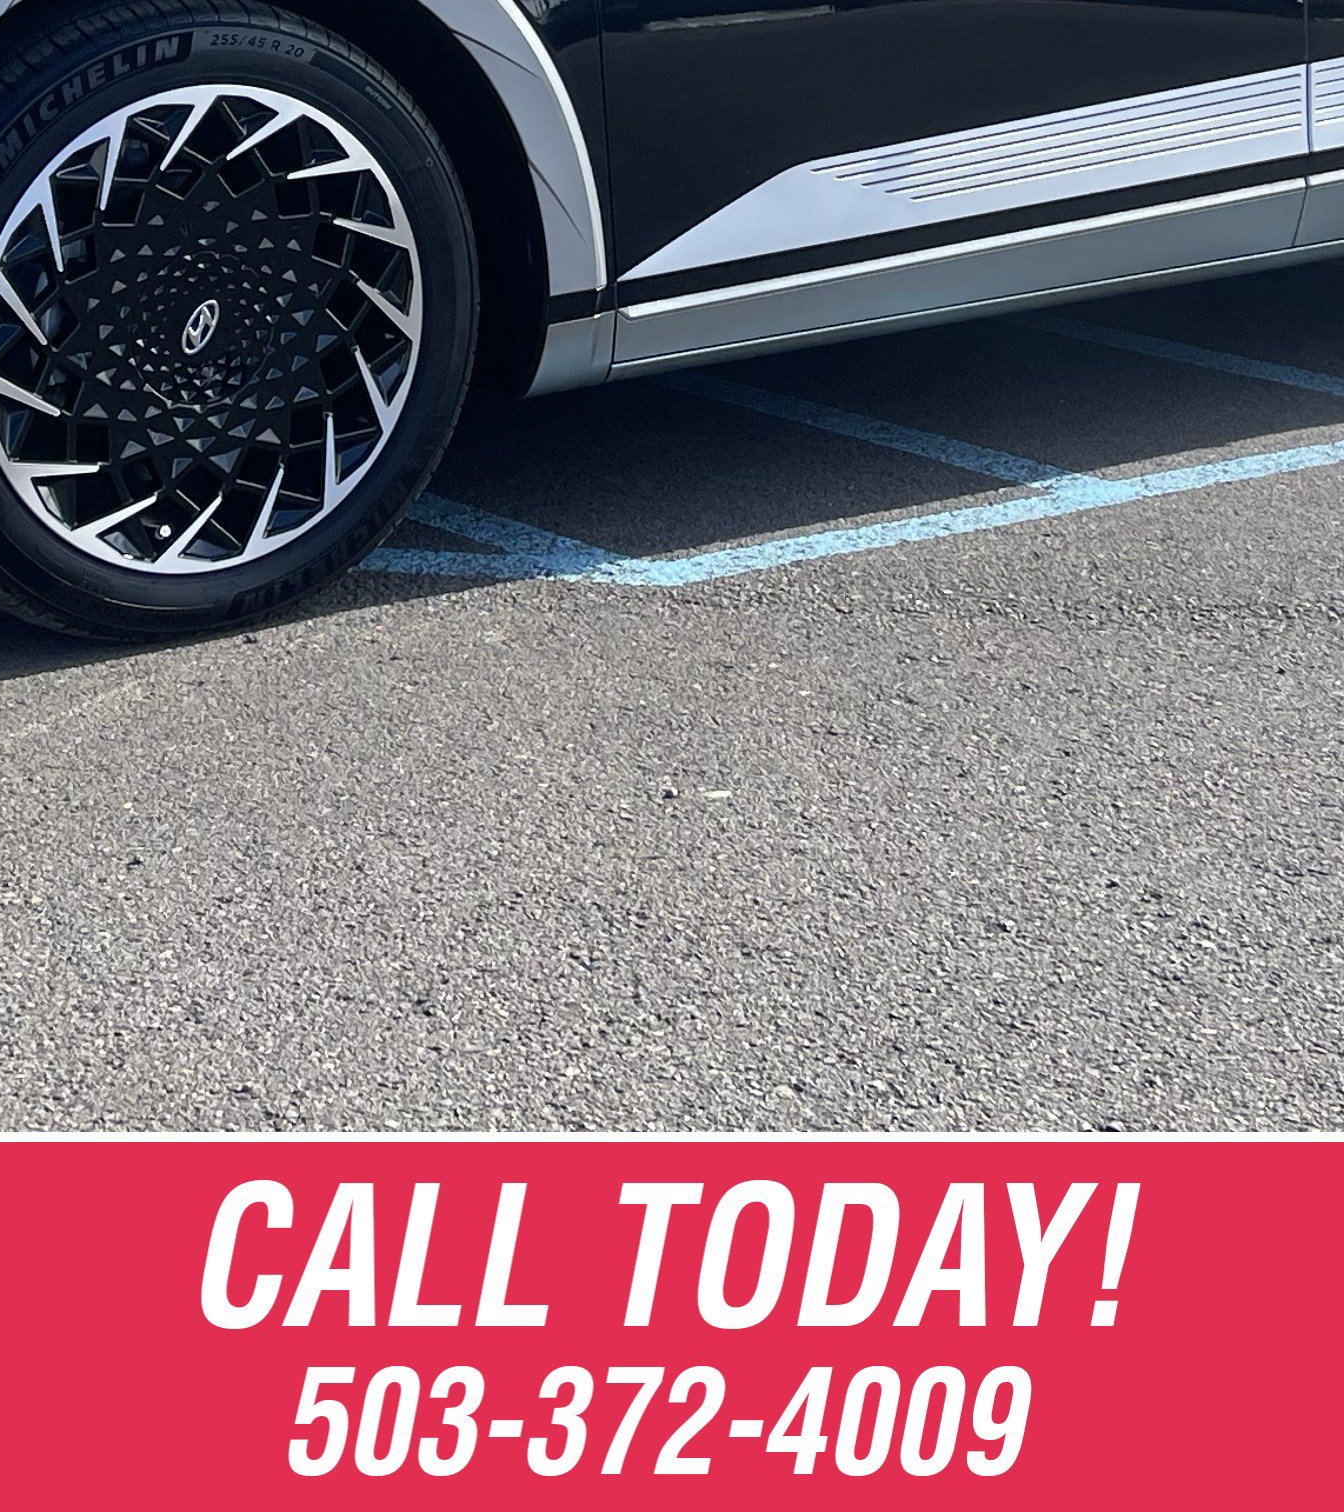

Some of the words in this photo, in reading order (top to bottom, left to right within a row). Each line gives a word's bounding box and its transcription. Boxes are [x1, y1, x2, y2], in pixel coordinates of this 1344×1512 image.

[210, 33, 267, 48] 255/45
[270, 39, 281, 52] R
[284, 44, 305, 58] 20
